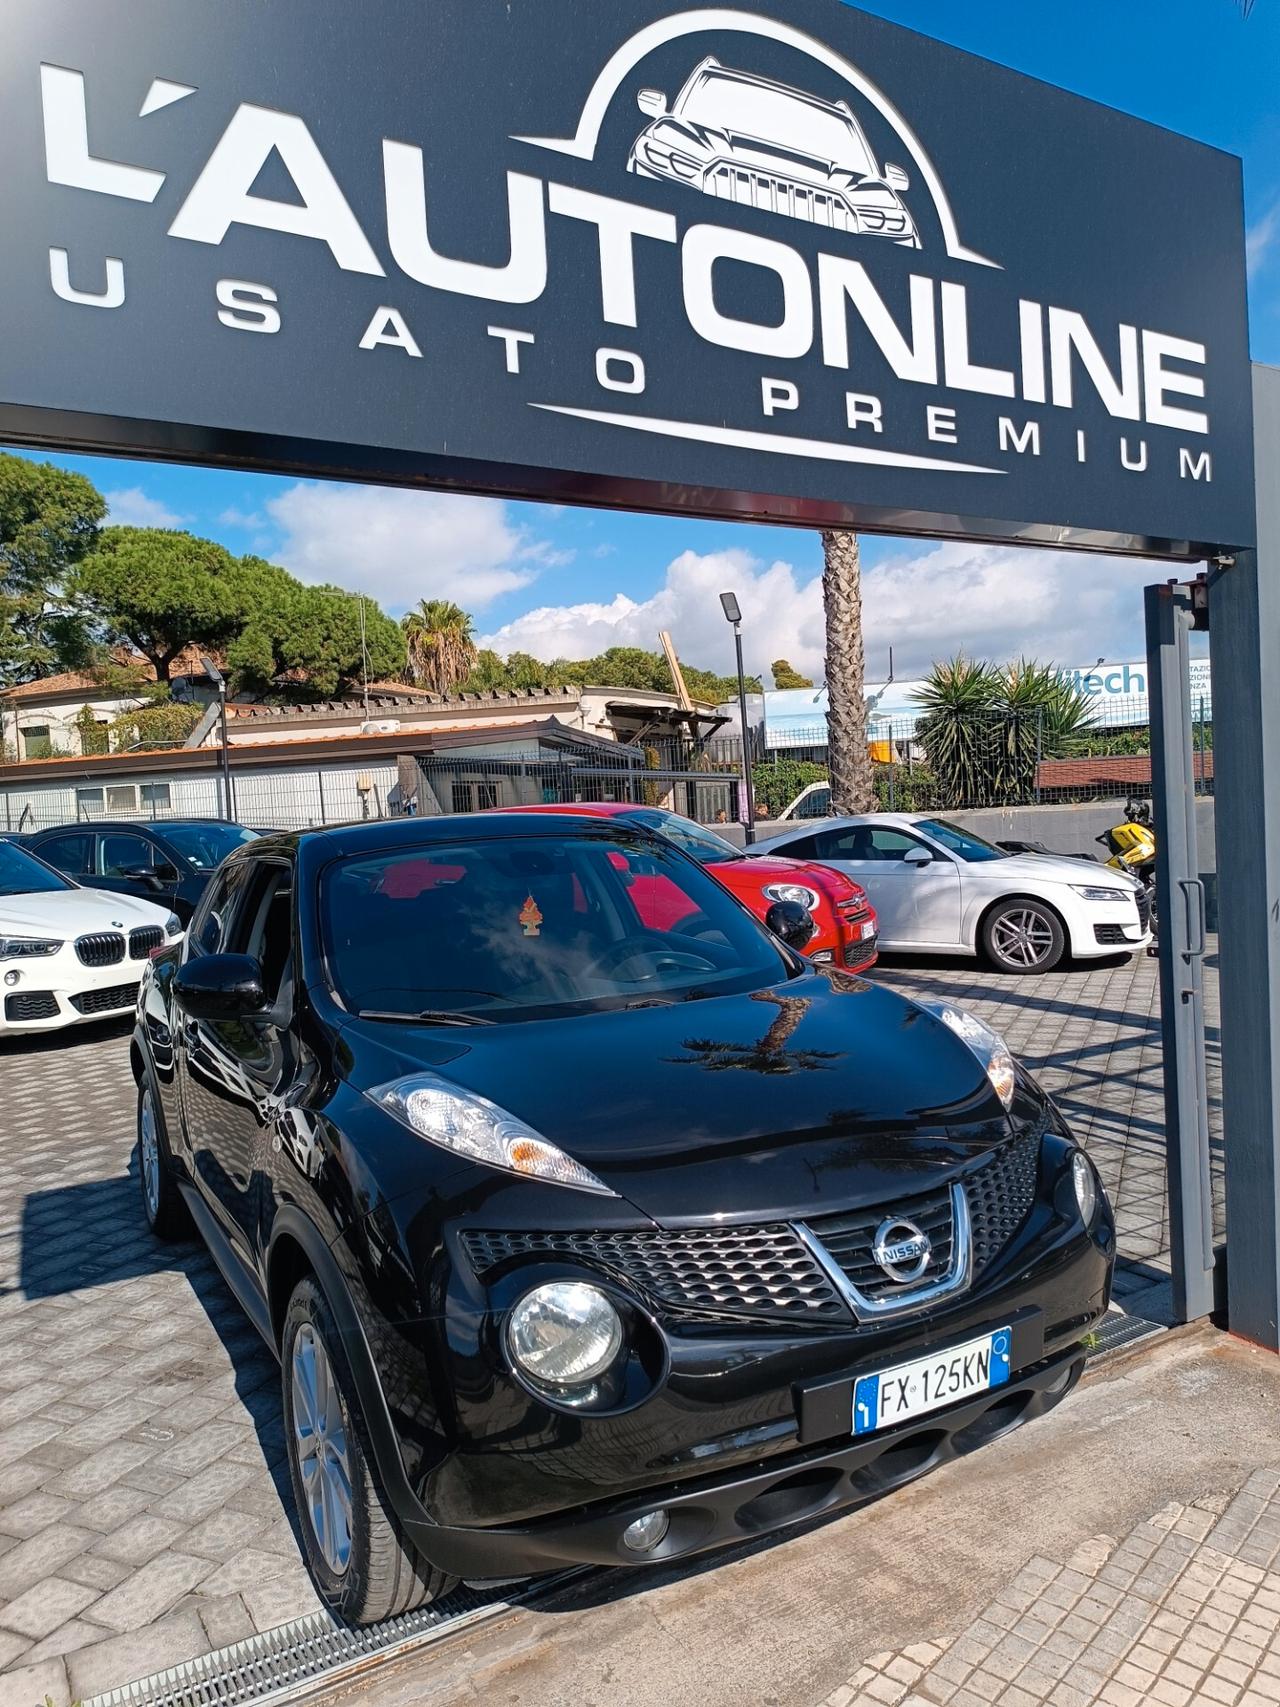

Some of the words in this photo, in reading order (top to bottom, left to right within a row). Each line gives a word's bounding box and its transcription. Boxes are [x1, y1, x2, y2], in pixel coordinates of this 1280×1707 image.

[49, 246, 646, 394] USATO
[762, 377, 1212, 482] PREMIUM
[883, 1240, 928, 1260] NISSAN
